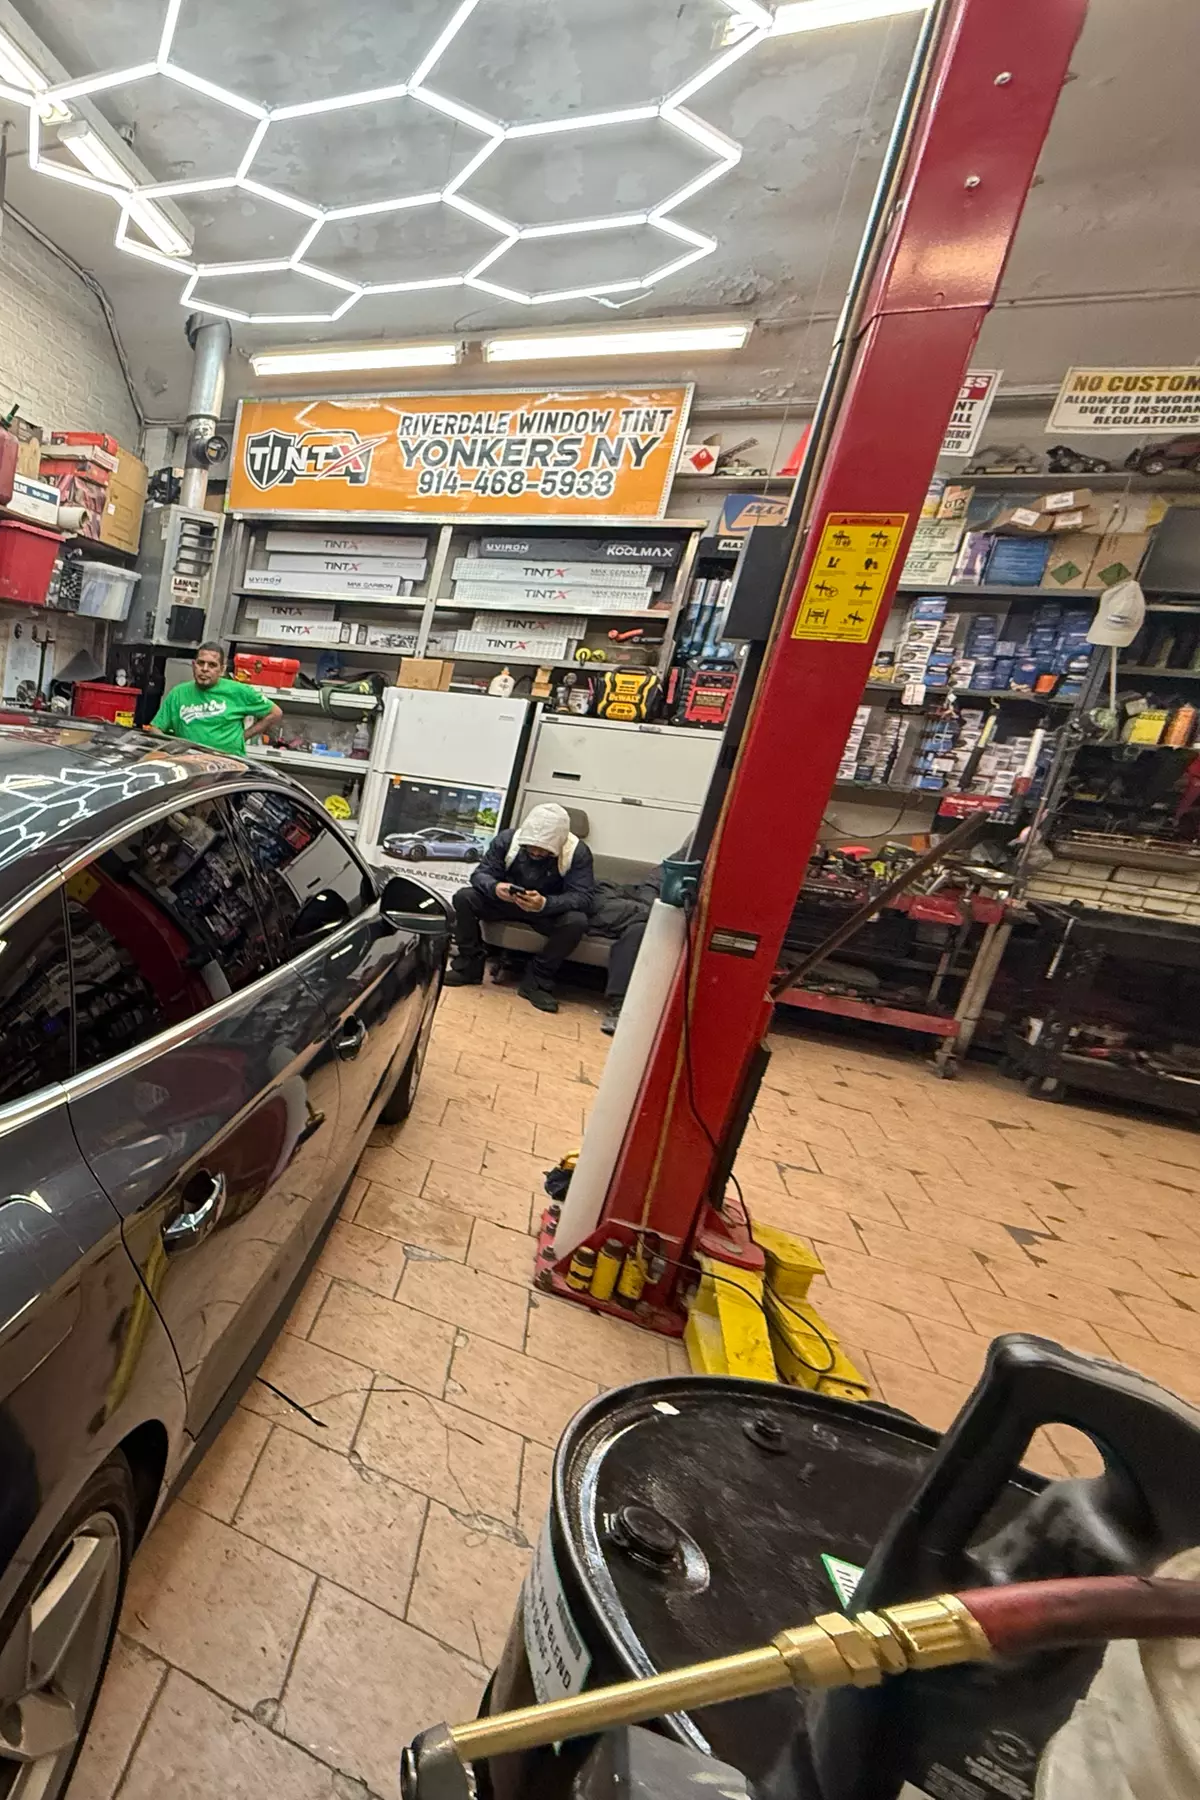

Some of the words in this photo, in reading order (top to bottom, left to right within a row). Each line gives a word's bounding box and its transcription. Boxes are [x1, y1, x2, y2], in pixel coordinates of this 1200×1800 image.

[1072, 375, 1101, 391] NO
[1064, 395, 1132, 405] ALLOWED
[1134, 395, 1152, 404] IN
[1078, 405, 1107, 414] DUE
[1111, 405, 1130, 414] TO
[400, 411, 511, 437] RIVERDALE
[518, 410, 612, 434] WINDOW
[620, 408, 674, 433] TINT
[1092, 415, 1199, 424] REGULATIONS
[400, 436, 584, 469] YONKERS
[590, 436, 661, 468] NY
[417, 470, 615, 497] 914-468-5933
[323, 539, 364, 550] TINTX
[485, 543, 530, 553] UVIRON
[605, 546, 674, 558] KOOLMAX
[323, 561, 364, 572] TINTX
[522, 567, 571, 579] TINTX
[524, 588, 573, 600] TINTX
[270, 605, 305, 616] TINTX
[280, 624, 314, 635] TINTX
[505, 618, 551, 630] TINTX
[486, 638, 532, 650] TINTX
